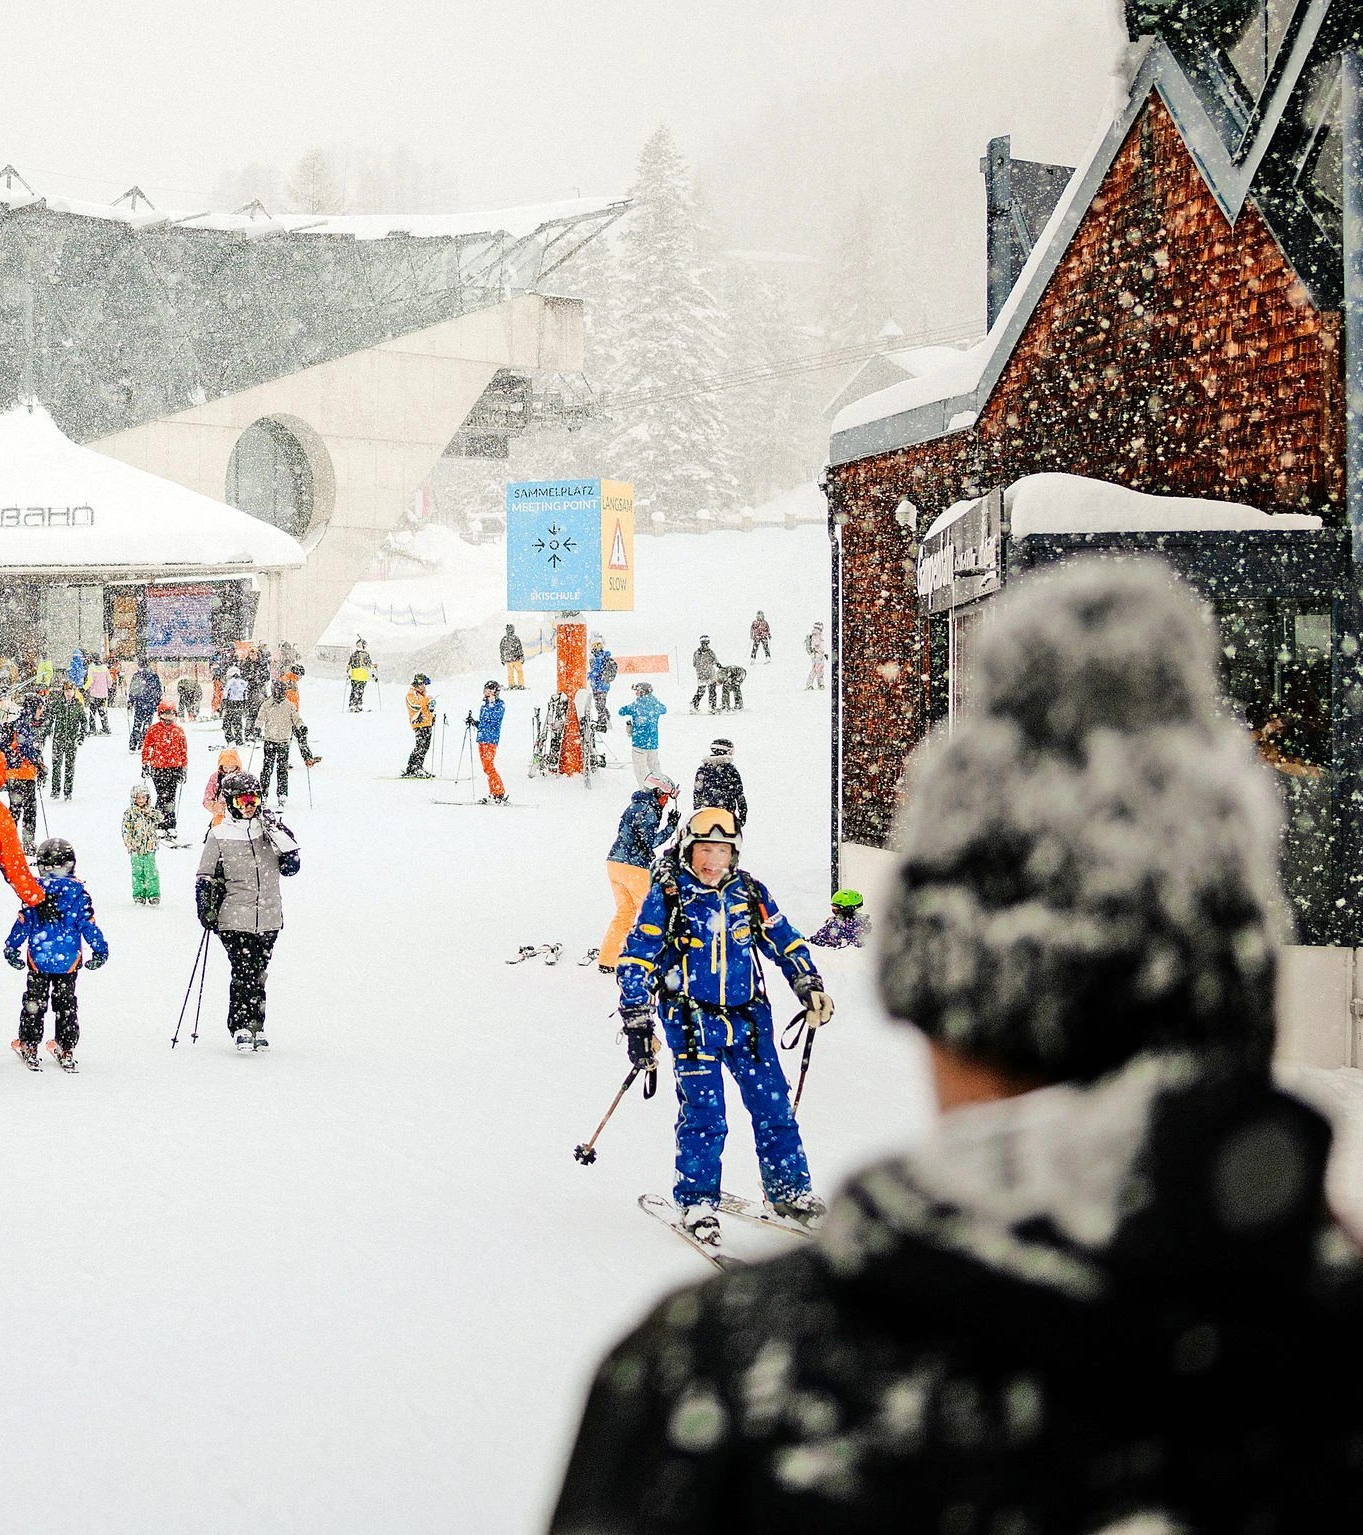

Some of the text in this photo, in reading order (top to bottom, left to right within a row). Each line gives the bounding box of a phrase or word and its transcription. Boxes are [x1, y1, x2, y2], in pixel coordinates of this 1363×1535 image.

[514, 486, 594, 498] SAMMELPLATZ
[511, 501, 597, 512] MEETING POINT
[602, 496, 633, 512] LANGSAM
[608, 577, 628, 591] SLOW
[530, 591, 581, 601] SKISCHULE
